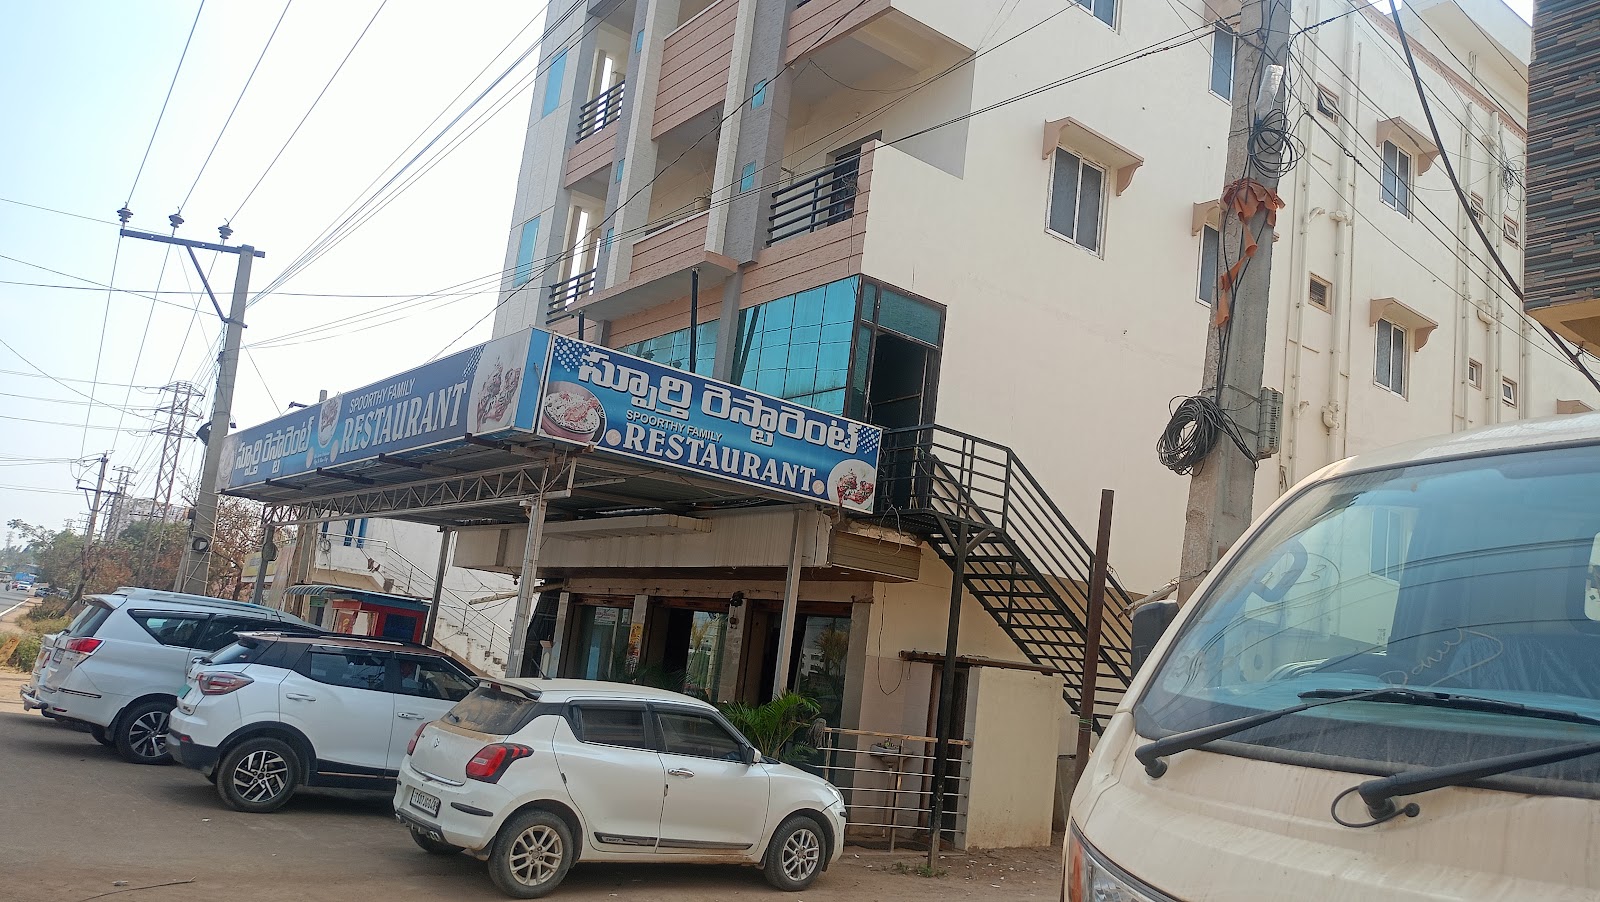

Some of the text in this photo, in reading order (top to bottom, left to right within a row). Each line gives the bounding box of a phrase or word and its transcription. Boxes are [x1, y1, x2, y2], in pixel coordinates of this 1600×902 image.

[339, 380, 468, 454] RESTAURANT
[349, 378, 416, 413] SPOORTHY FAMILY
[626, 409, 723, 443] SPOORTHY FAMILY
[701, 383, 863, 454] రెస్టారెంట్
[623, 422, 816, 492] RESTAURANT
